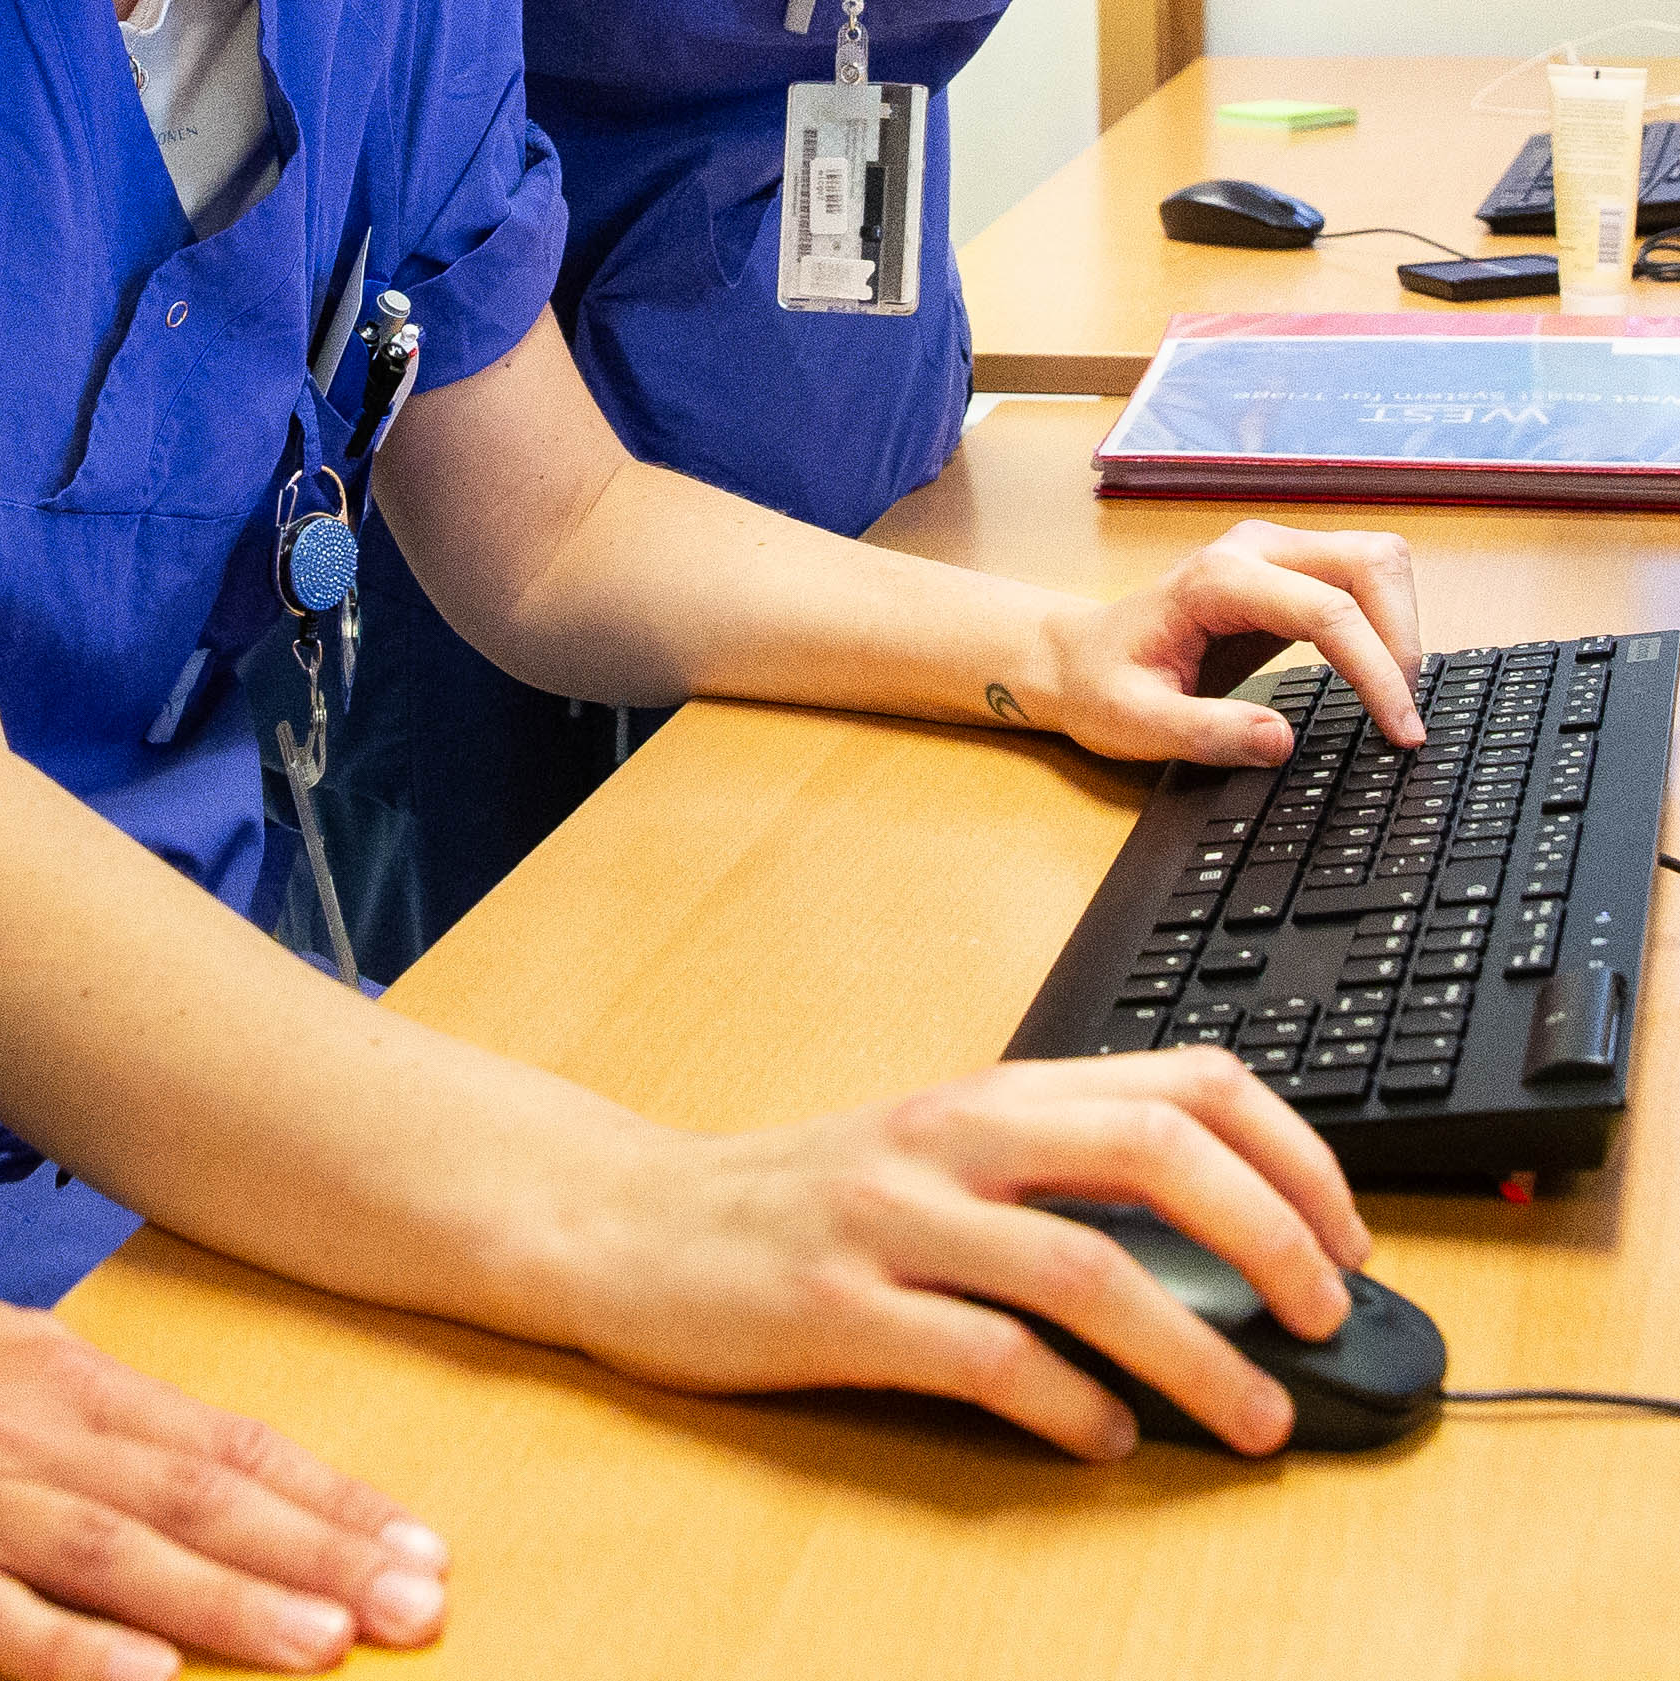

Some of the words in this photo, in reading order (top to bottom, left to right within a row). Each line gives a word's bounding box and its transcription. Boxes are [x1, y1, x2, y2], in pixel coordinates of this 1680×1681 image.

[1231, 389, 1326, 403] Triage
[1339, 390, 1382, 403] for
[1358, 406, 1551, 424] WEST
